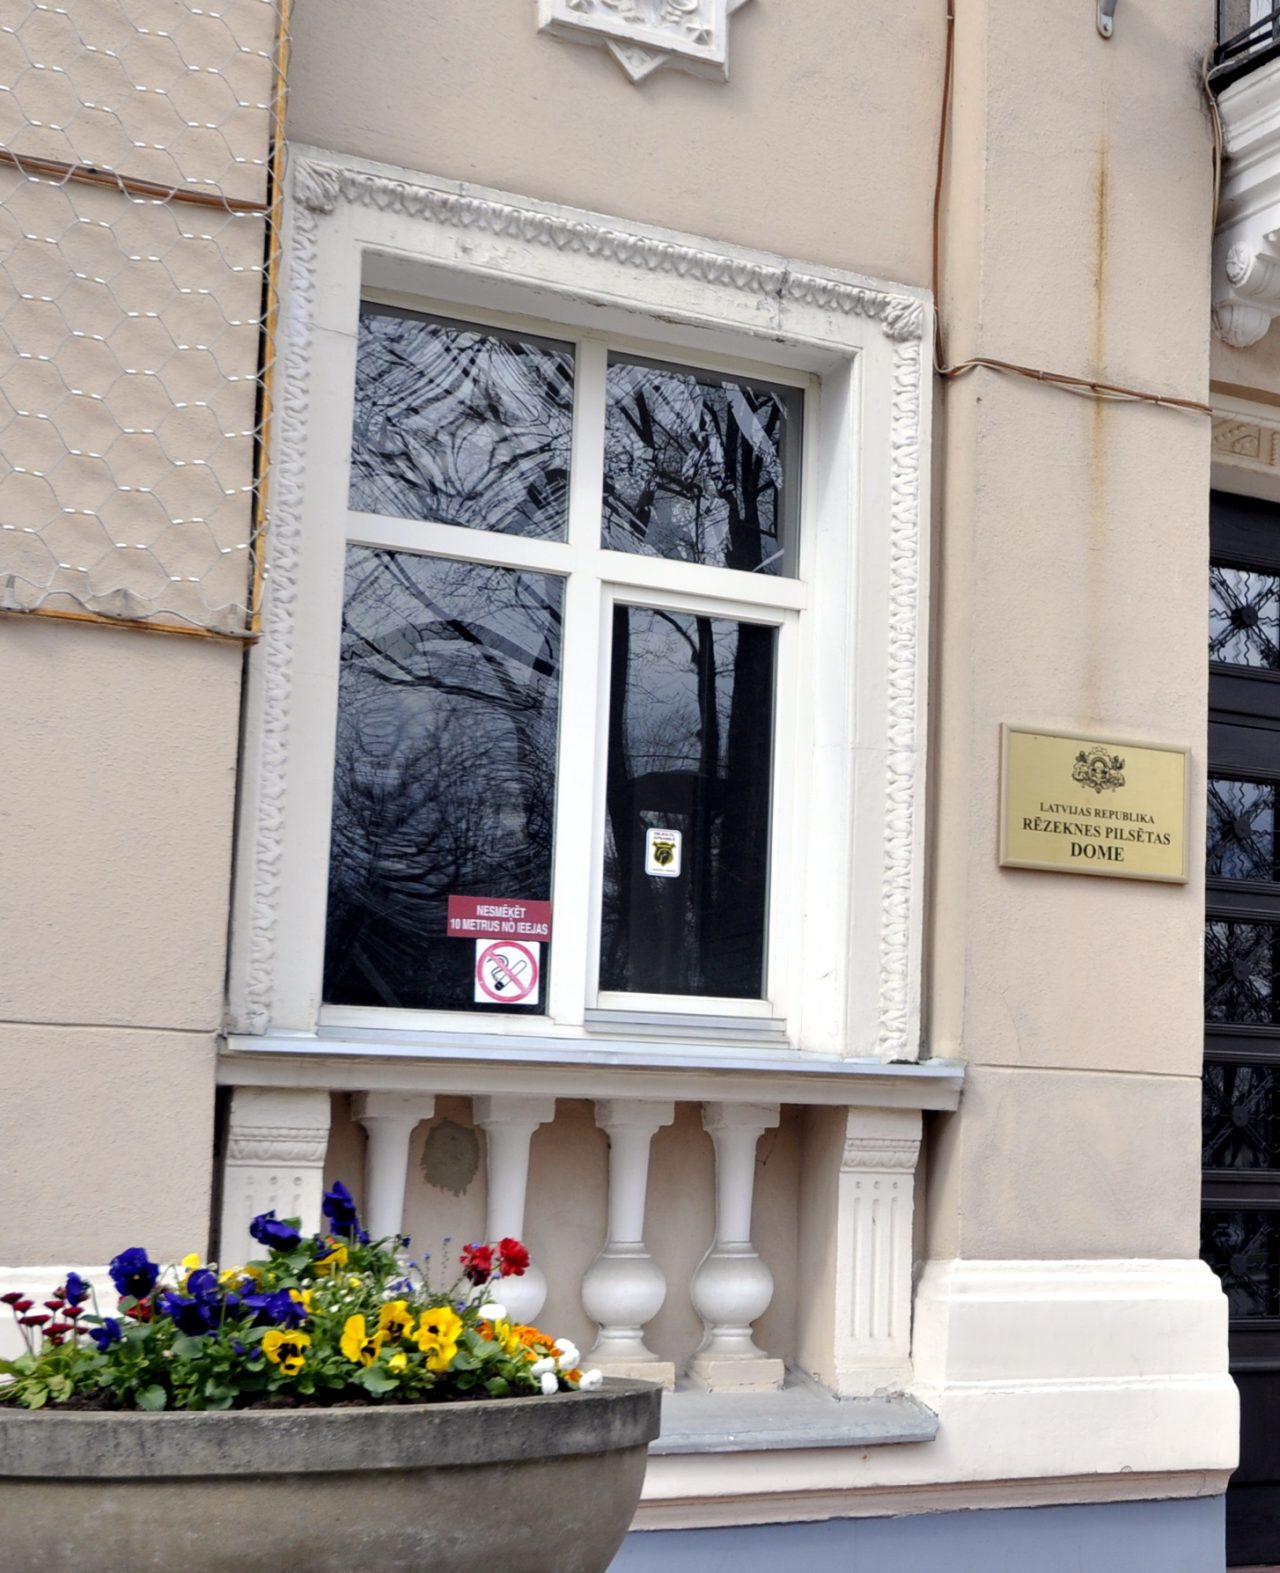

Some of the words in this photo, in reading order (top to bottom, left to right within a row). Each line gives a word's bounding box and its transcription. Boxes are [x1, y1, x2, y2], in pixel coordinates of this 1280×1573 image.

[1039, 802, 1092, 817] LATVIJAS
[1094, 808, 1155, 824] REPUBLIKA
[1022, 816, 1101, 838] RĒZEKNES
[1105, 826, 1171, 845] PILSĒTAS
[1070, 842, 1124, 862] DOME
[450, 918, 461, 930] 10
[462, 919, 500, 932] METRUS
[501, 921, 516, 933] NO
[517, 922, 549, 935] IEEJAS
